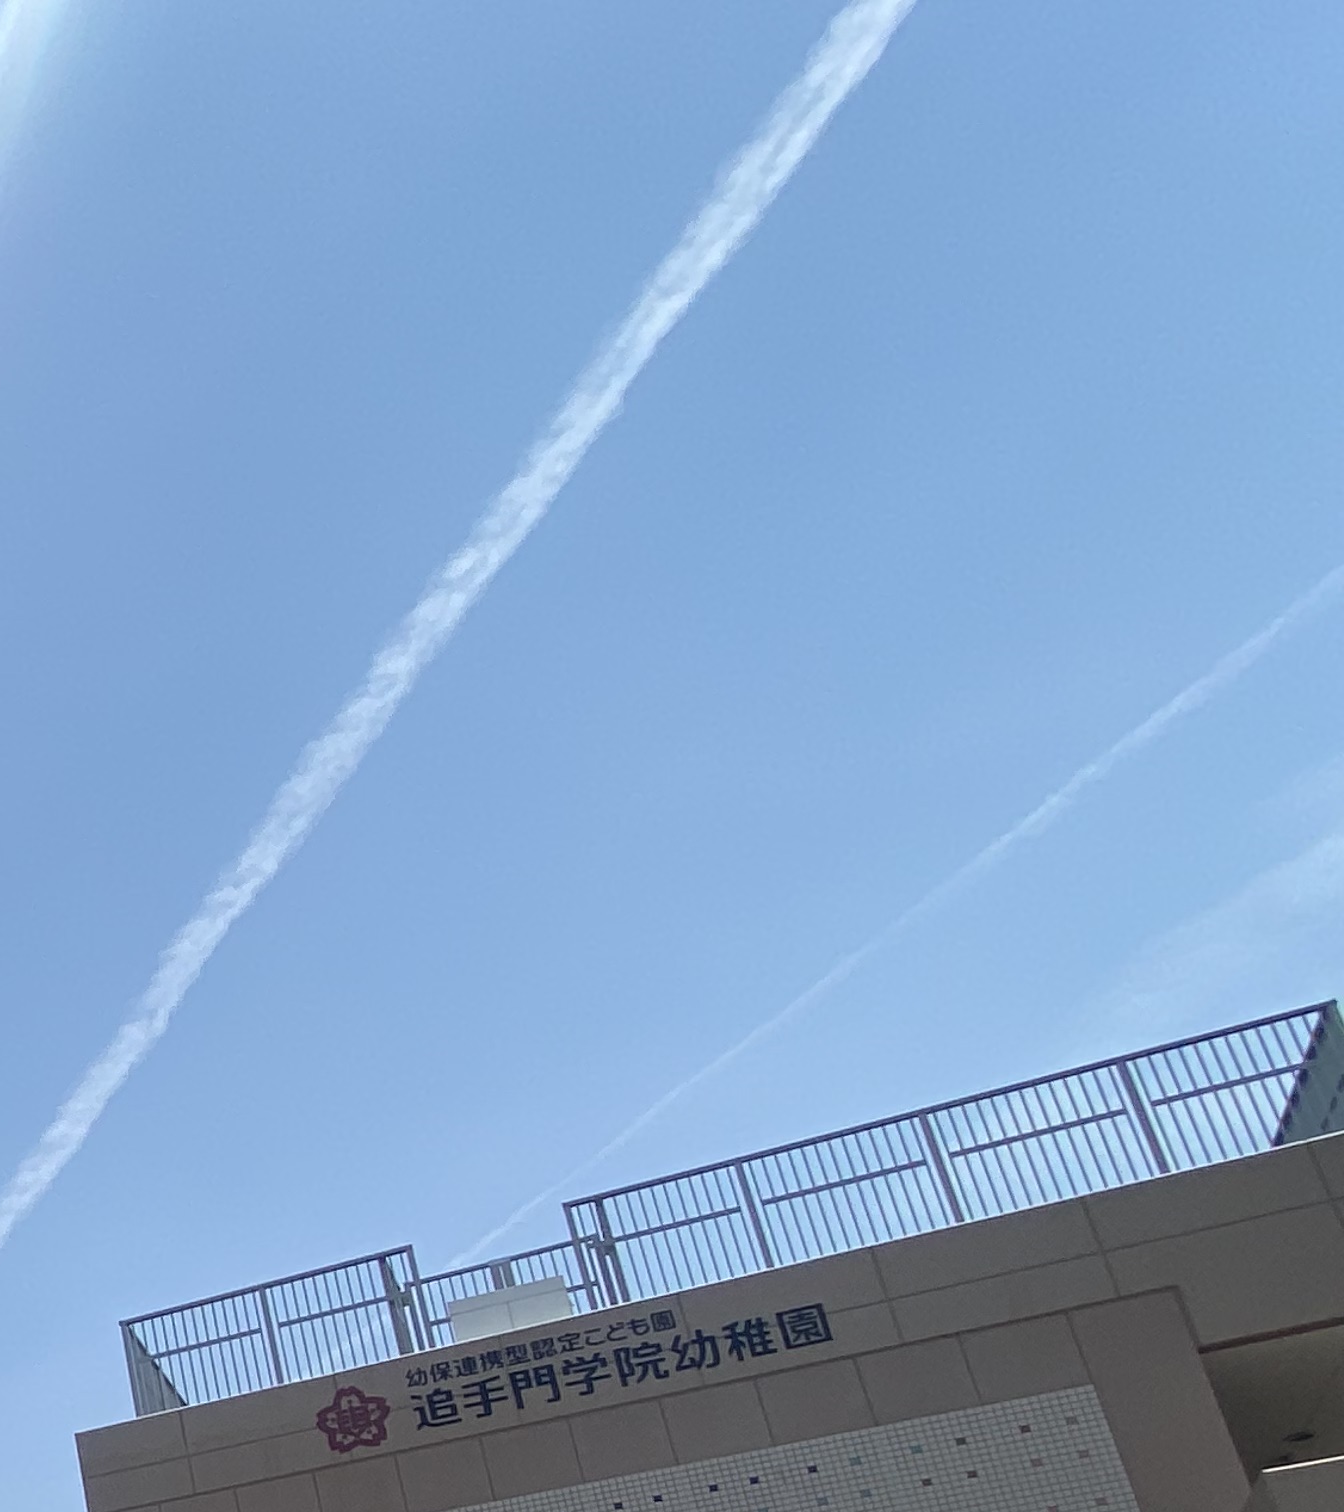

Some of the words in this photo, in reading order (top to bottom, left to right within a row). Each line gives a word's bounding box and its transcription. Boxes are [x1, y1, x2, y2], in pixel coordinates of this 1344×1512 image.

[405, 1310, 676, 1387] 幼保連携型認定こども園
[410, 1302, 834, 1430] 追手門学院幼稚園
